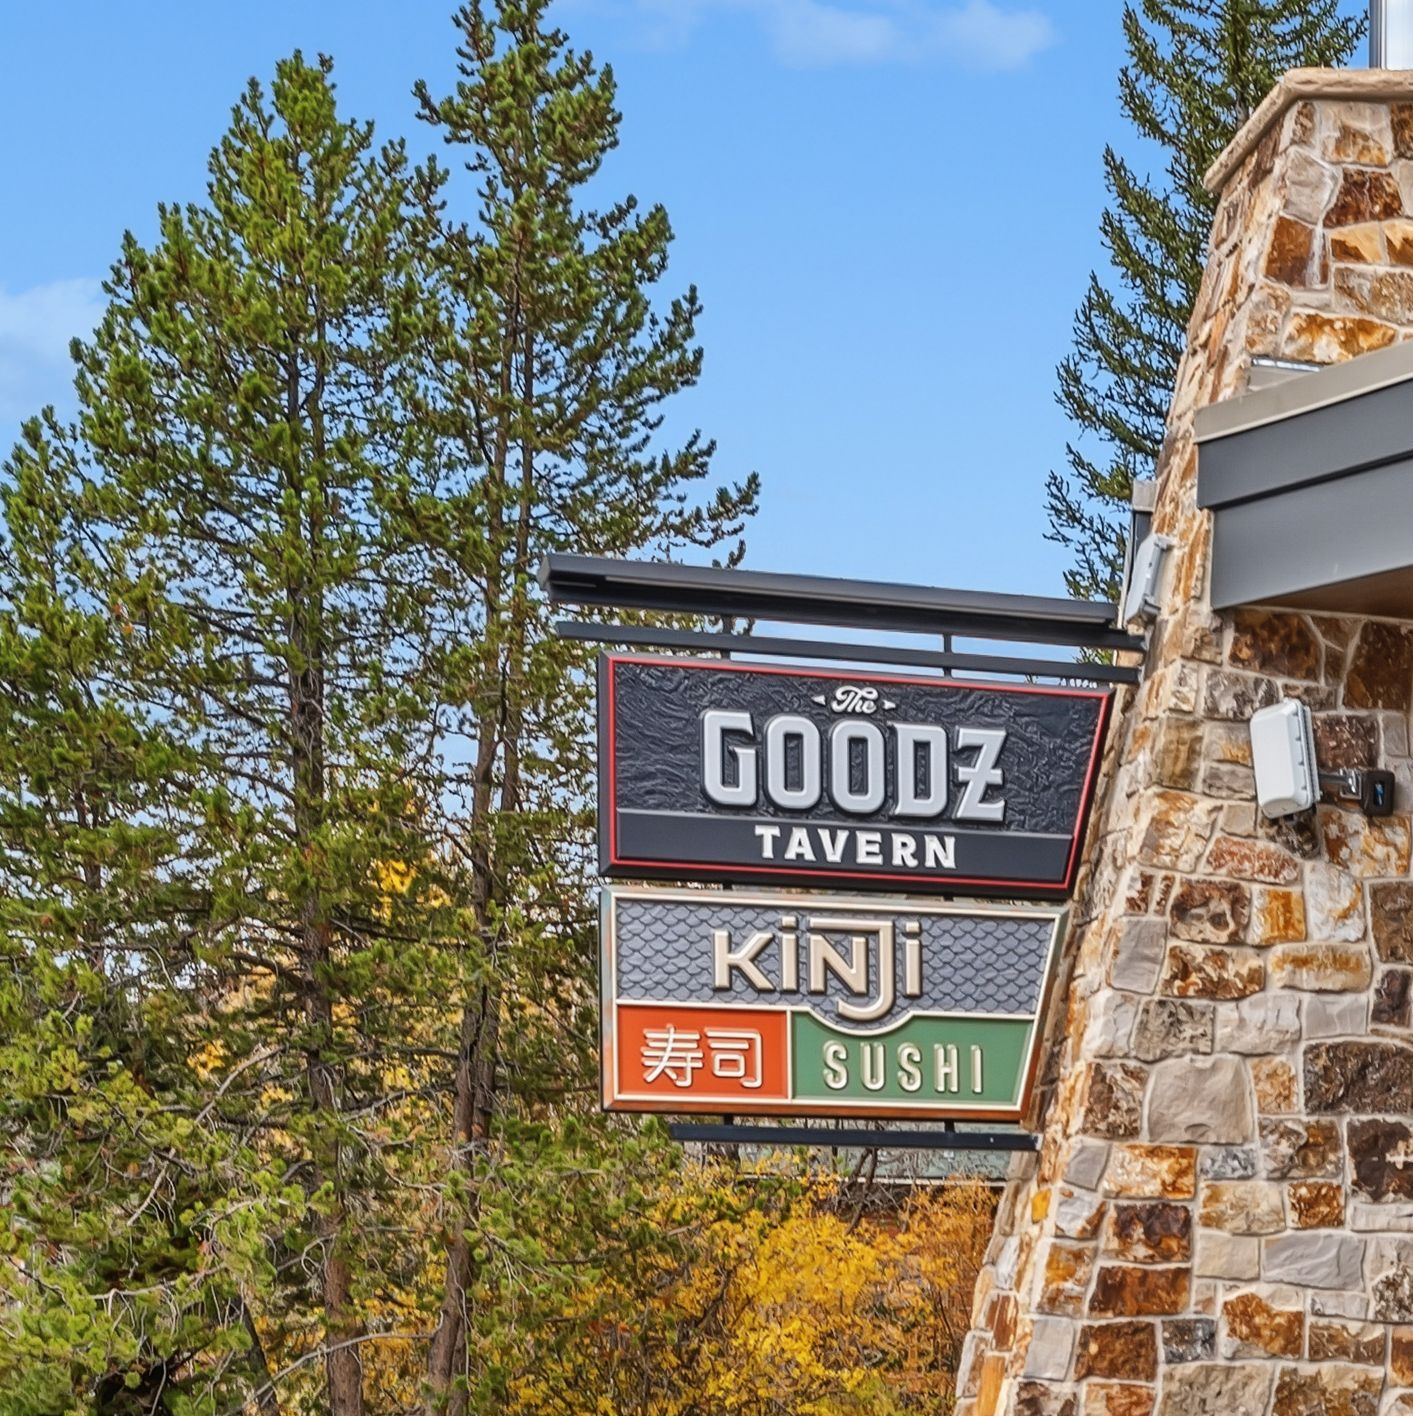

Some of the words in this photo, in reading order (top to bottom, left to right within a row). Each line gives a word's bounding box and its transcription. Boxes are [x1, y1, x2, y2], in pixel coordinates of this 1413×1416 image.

[830, 685, 880, 715] The
[702, 709, 1009, 823] GOODZ
[754, 825, 957, 869] TAVERN
[641, 1024, 763, 1089] 寿司
[823, 1040, 984, 1094] SUSHI
